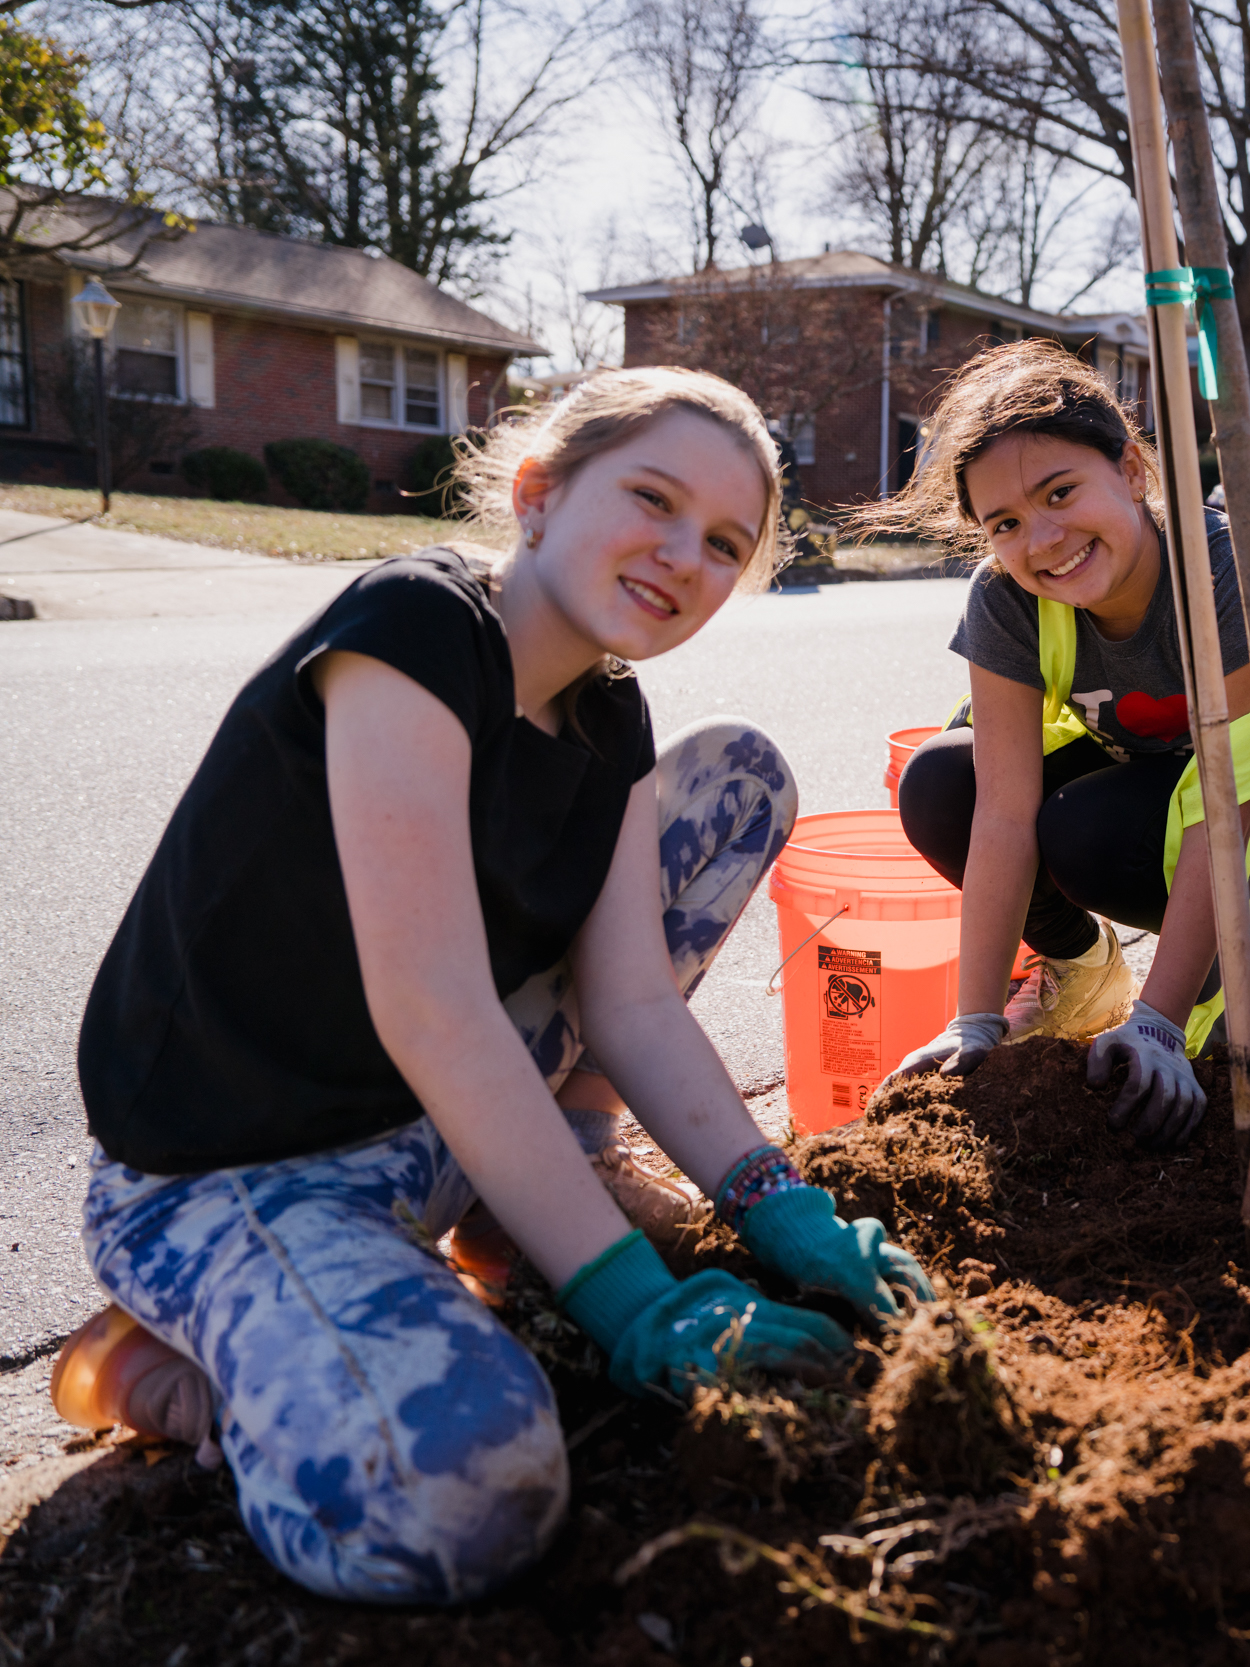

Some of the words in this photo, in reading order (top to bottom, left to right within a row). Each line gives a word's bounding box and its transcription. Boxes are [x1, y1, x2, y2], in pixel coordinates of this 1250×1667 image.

[836, 949, 867, 958] WARNING
[831, 956, 874, 966] ADVERTENCIA
[827, 963, 878, 974] AVERTISSEMENT
